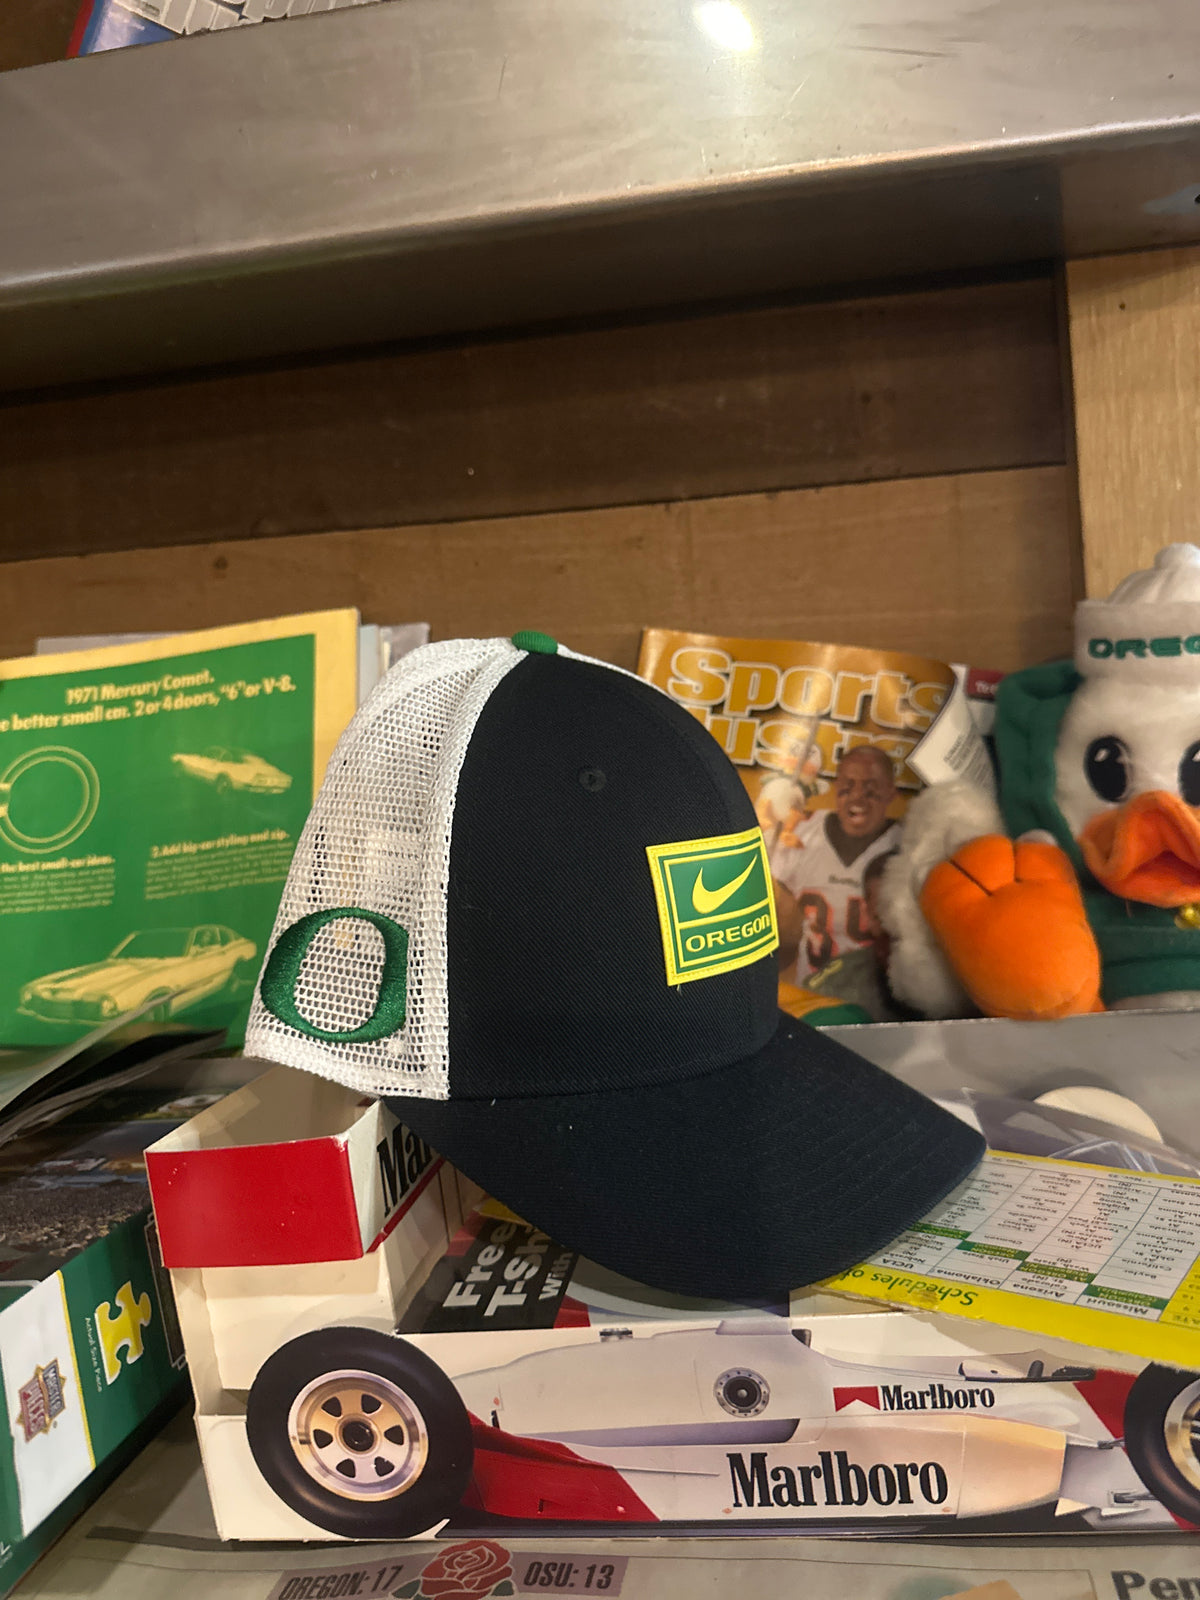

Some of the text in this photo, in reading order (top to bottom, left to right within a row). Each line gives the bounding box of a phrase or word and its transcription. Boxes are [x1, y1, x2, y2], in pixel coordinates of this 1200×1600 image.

[11, 713, 60, 731] better
[62, 705, 104, 726] small
[105, 706, 131, 720] car.
[134, 699, 145, 717] 2
[145, 701, 160, 715] or
[162, 695, 171, 711] 4
[173, 691, 220, 710] doors,
[244, 684, 261, 697] or
[262, 674, 297, 694] V-8.
[66, 669, 215, 705] 1971 Mercury Comet.
[667, 646, 953, 733] Sports
[685, 914, 771, 953] OREGON
[443, 1222, 518, 1308] Free
[484, 1225, 553, 1316] T-Sh
[538, 1251, 574, 1300] with
[882, 1258, 914, 1269] UCLA
[936, 1268, 1000, 1286] Oklahoma
[987, 1256, 1010, 1264] Utah
[1123, 1269, 1157, 1279] Baylor
[871, 1273, 979, 1306] Schedules
[1012, 1284, 1065, 1298] Arizona
[1020, 1277, 1068, 1290] Colorado
[1086, 1298, 1149, 1315] Missouri
[880, 1384, 995, 1411] Marlboro
[726, 1451, 949, 1508] Marlboro
[279, 1561, 615, 1600] OREGON: 17 OSU: 13
